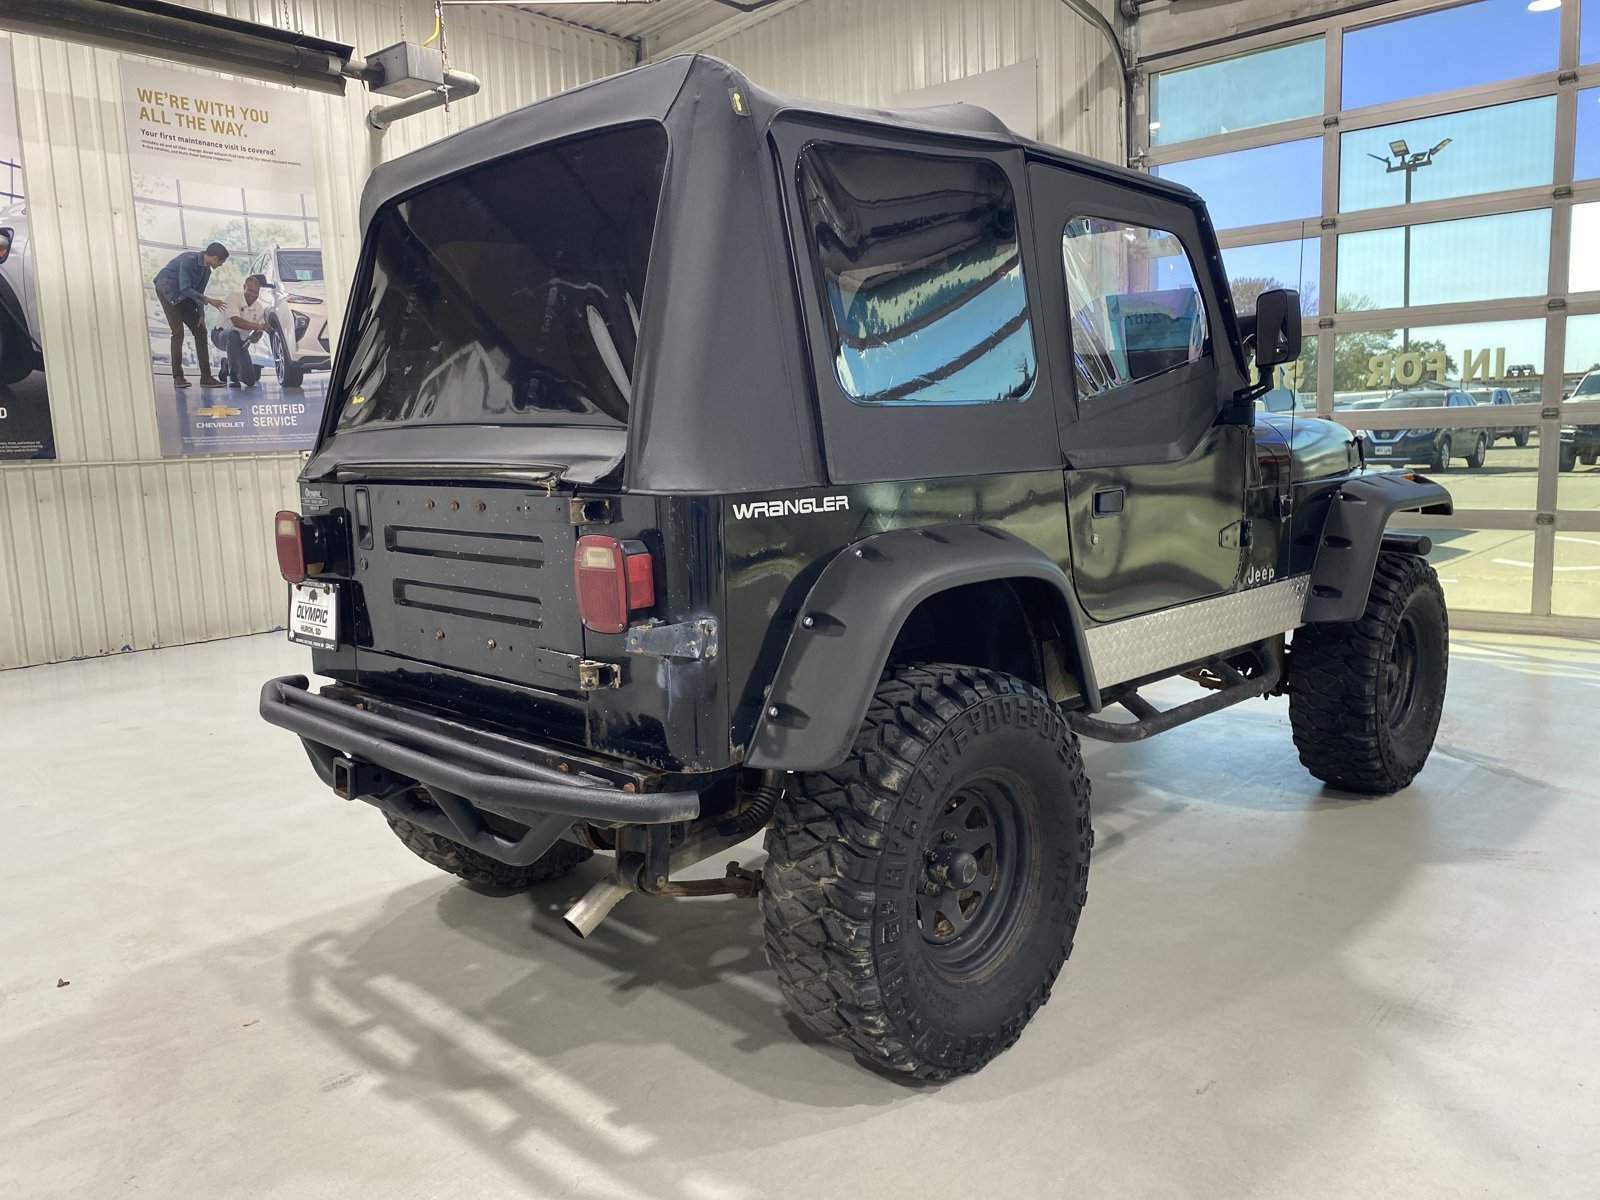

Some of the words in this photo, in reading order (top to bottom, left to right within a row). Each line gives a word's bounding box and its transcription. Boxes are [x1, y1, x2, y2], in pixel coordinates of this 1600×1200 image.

[136, 87, 190, 111] WE'RE
[193, 98, 235, 119] WITH
[239, 106, 270, 124] YOU
[139, 106, 171, 126] ALL
[174, 113, 207, 132] THE
[210, 118, 248, 138] WAY.
[140, 128, 158, 138] Your
[159, 131, 176, 142] first
[177, 135, 223, 149] maintenance
[224, 142, 239, 152] visit
[240, 144, 247, 152] is
[251, 403, 306, 416] CERTIFIED
[196, 421, 245, 429] CHEVROLET
[252, 415, 298, 427] SERVICE
[732, 495, 850, 520] WRANGLER
[1247, 566, 1275, 585] Jeep
[296, 604, 329, 624] OLYMPIC
